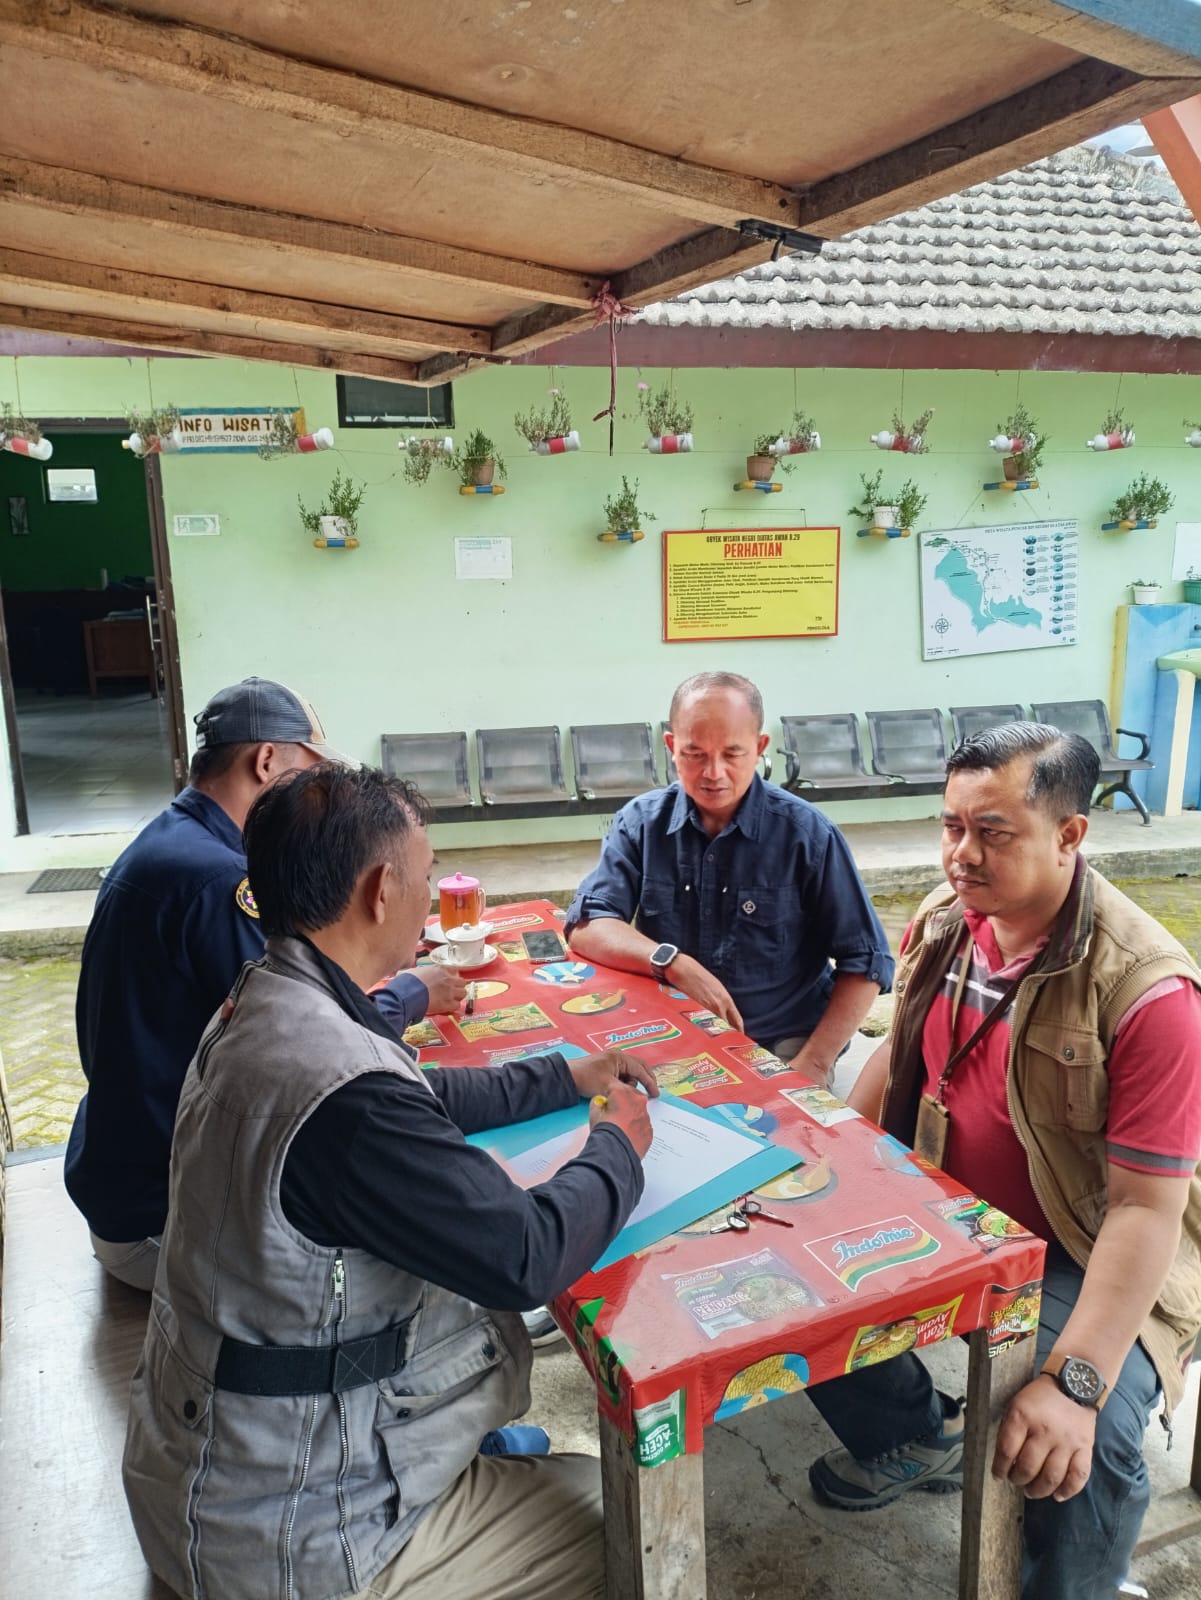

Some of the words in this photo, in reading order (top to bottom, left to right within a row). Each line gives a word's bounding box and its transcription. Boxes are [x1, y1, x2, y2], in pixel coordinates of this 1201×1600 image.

[180, 418, 212, 432] INFO
[223, 417, 280, 432] WISAT
[724, 542, 782, 558] PERHATIAN
[605, 1025, 668, 1046] Indomie
[832, 1227, 915, 1268] Indomie
[917, 1310, 951, 1335] Ayam
[923, 1320, 945, 1344] Kari
[640, 1429, 672, 1456] ACEH
